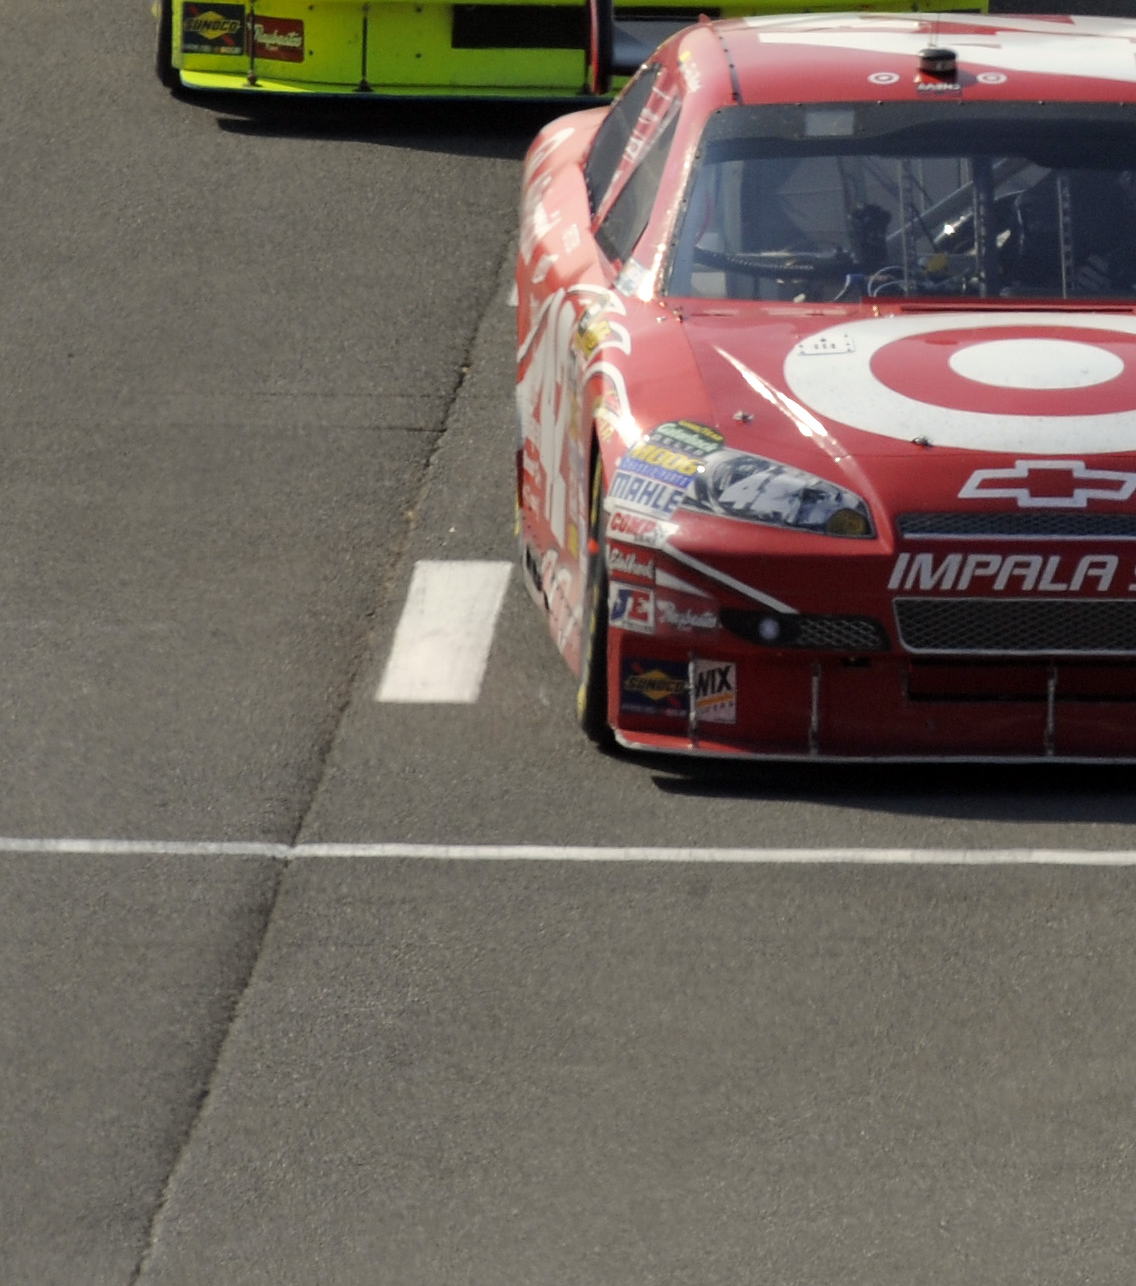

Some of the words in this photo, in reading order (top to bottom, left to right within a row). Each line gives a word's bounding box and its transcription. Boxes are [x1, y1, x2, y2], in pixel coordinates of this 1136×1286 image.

[184, 19, 242, 34] SUNOCO
[631, 444, 704, 476] MOOG
[612, 473, 684, 514] MAHLE
[887, 552, 1119, 591] IMPALA
[695, 667, 732, 698] WIX
